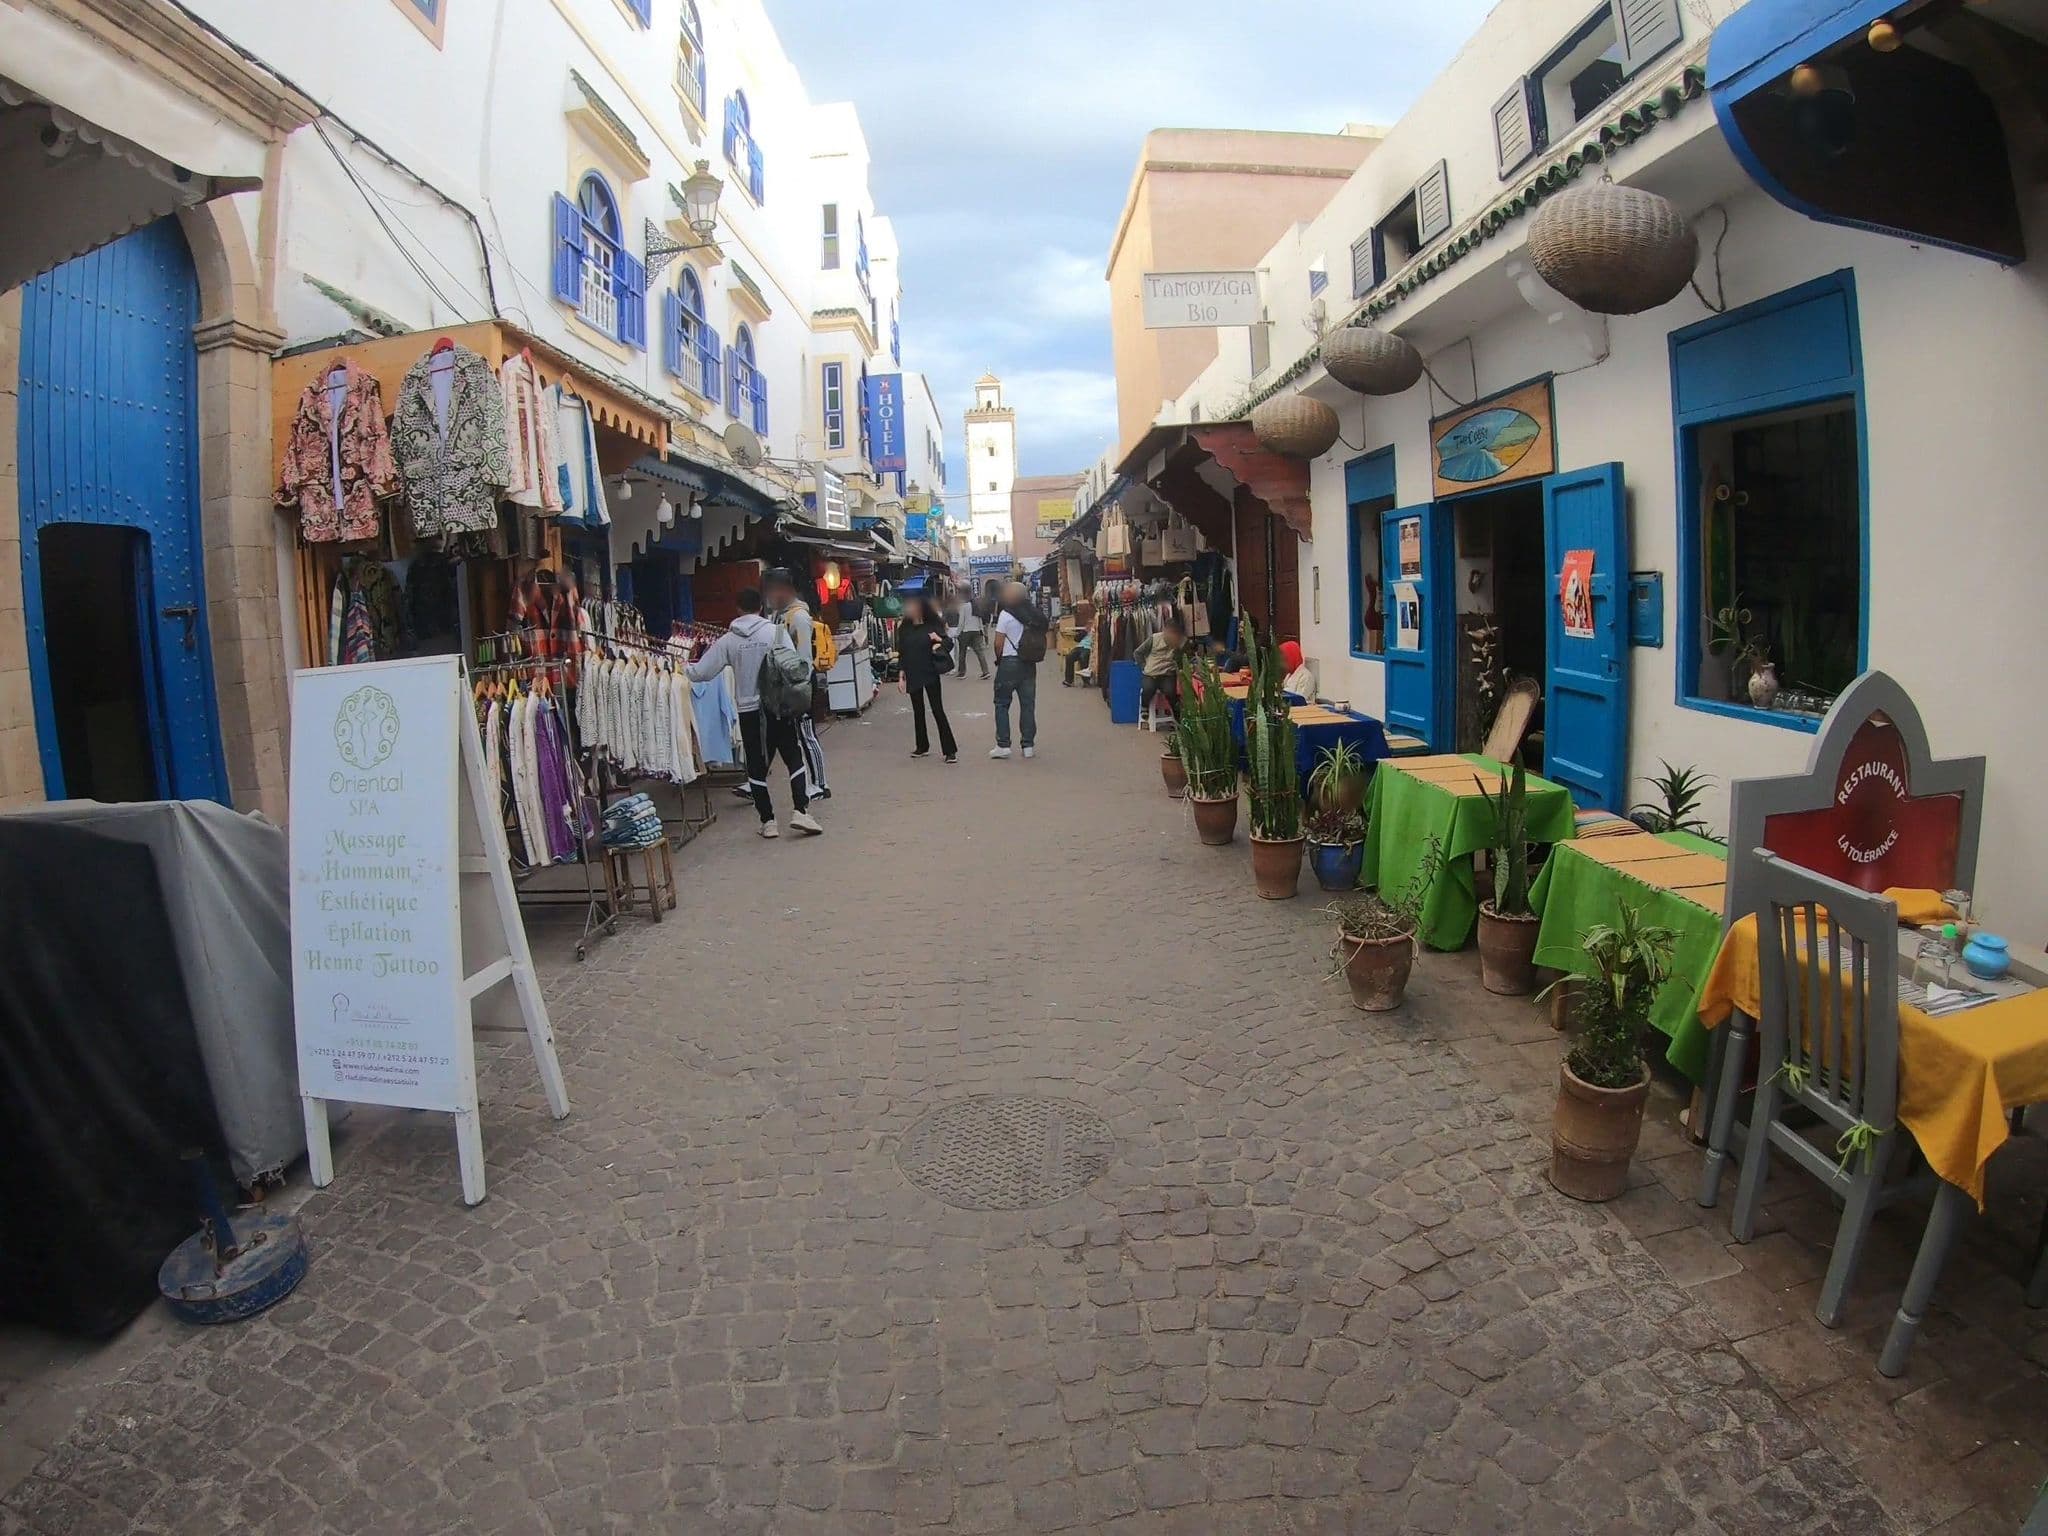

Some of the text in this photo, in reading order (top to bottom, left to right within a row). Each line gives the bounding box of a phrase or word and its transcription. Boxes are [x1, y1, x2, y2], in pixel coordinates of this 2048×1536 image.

[879, 393, 895, 456] HOTEL
[969, 555, 1013, 564] CHANGE
[329, 770, 404, 793] Oriental
[1838, 761, 1905, 805] RESTAURANT
[349, 799, 380, 816] SPA
[325, 829, 407, 858] Massage
[1838, 829, 1899, 863] LA TOLÉRANCE
[321, 858, 410, 881] Hammam
[319, 890, 419, 918] Esthétique
[372, 953, 440, 978] Tattoo
